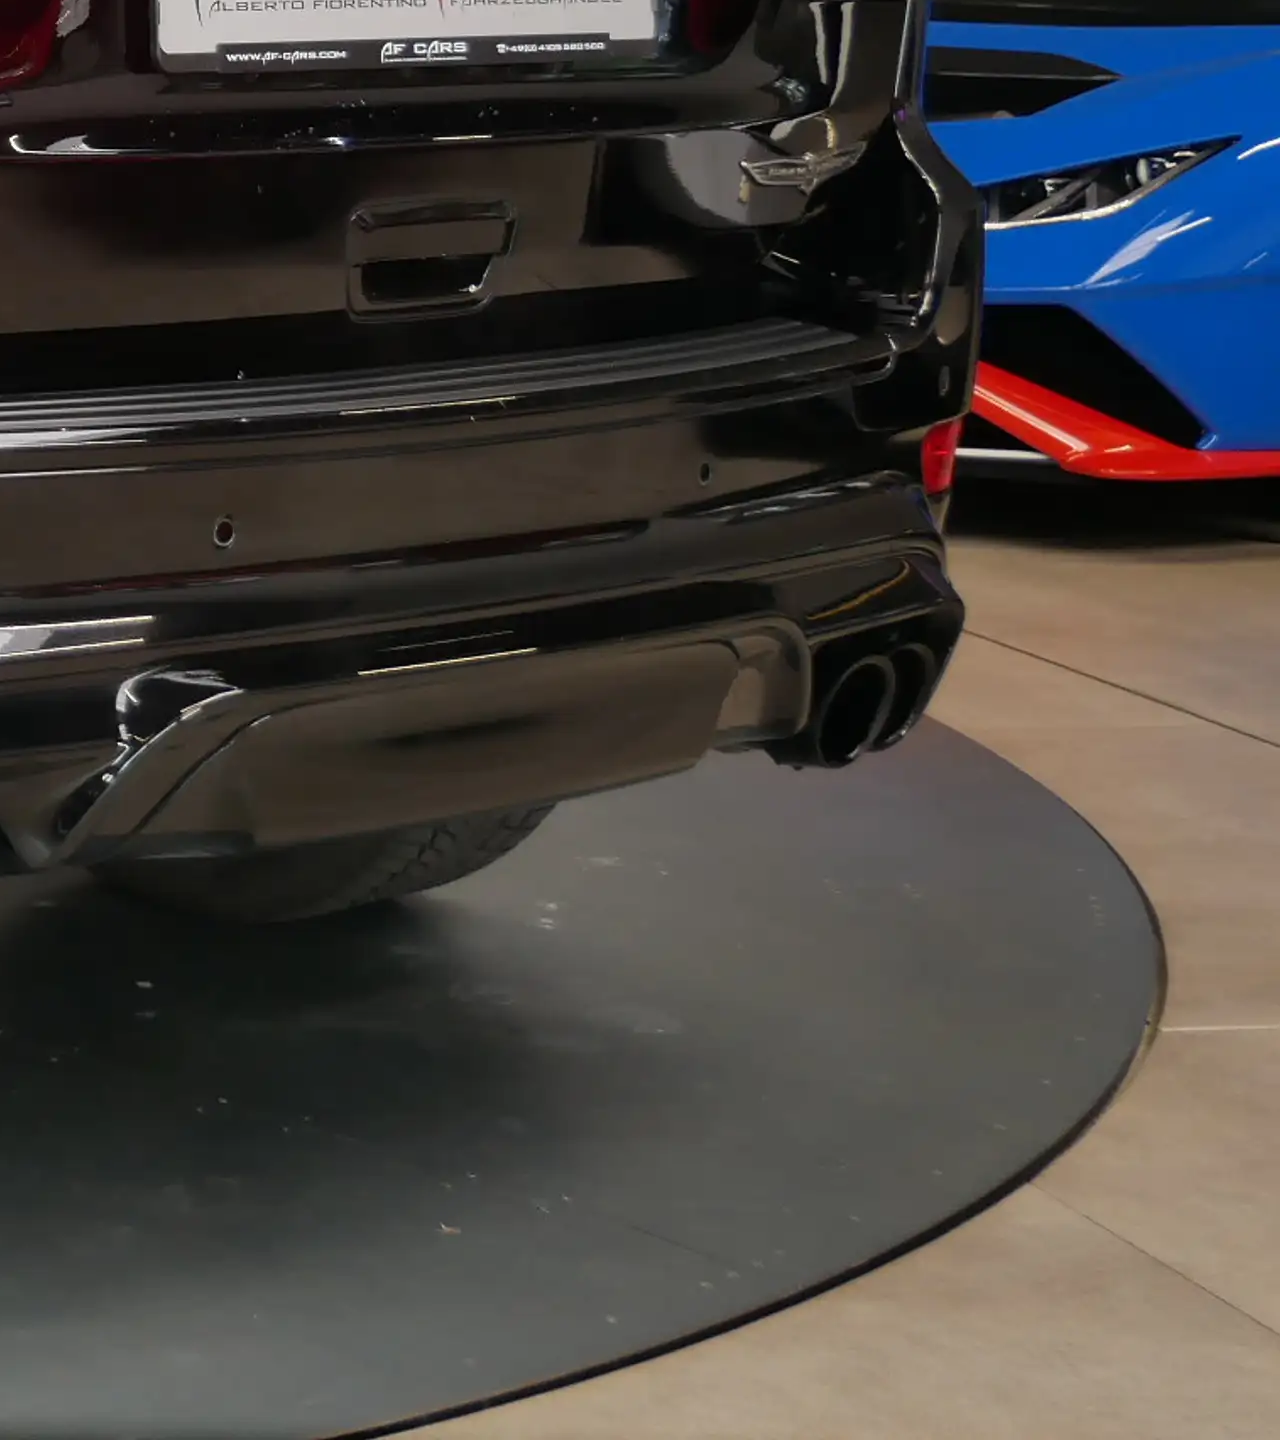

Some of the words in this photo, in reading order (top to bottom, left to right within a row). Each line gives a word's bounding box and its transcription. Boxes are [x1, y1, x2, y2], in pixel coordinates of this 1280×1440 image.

[208, 0, 305, 18] ALBERTO
[380, 41, 407, 63] AF
[413, 40, 468, 62] CARS
